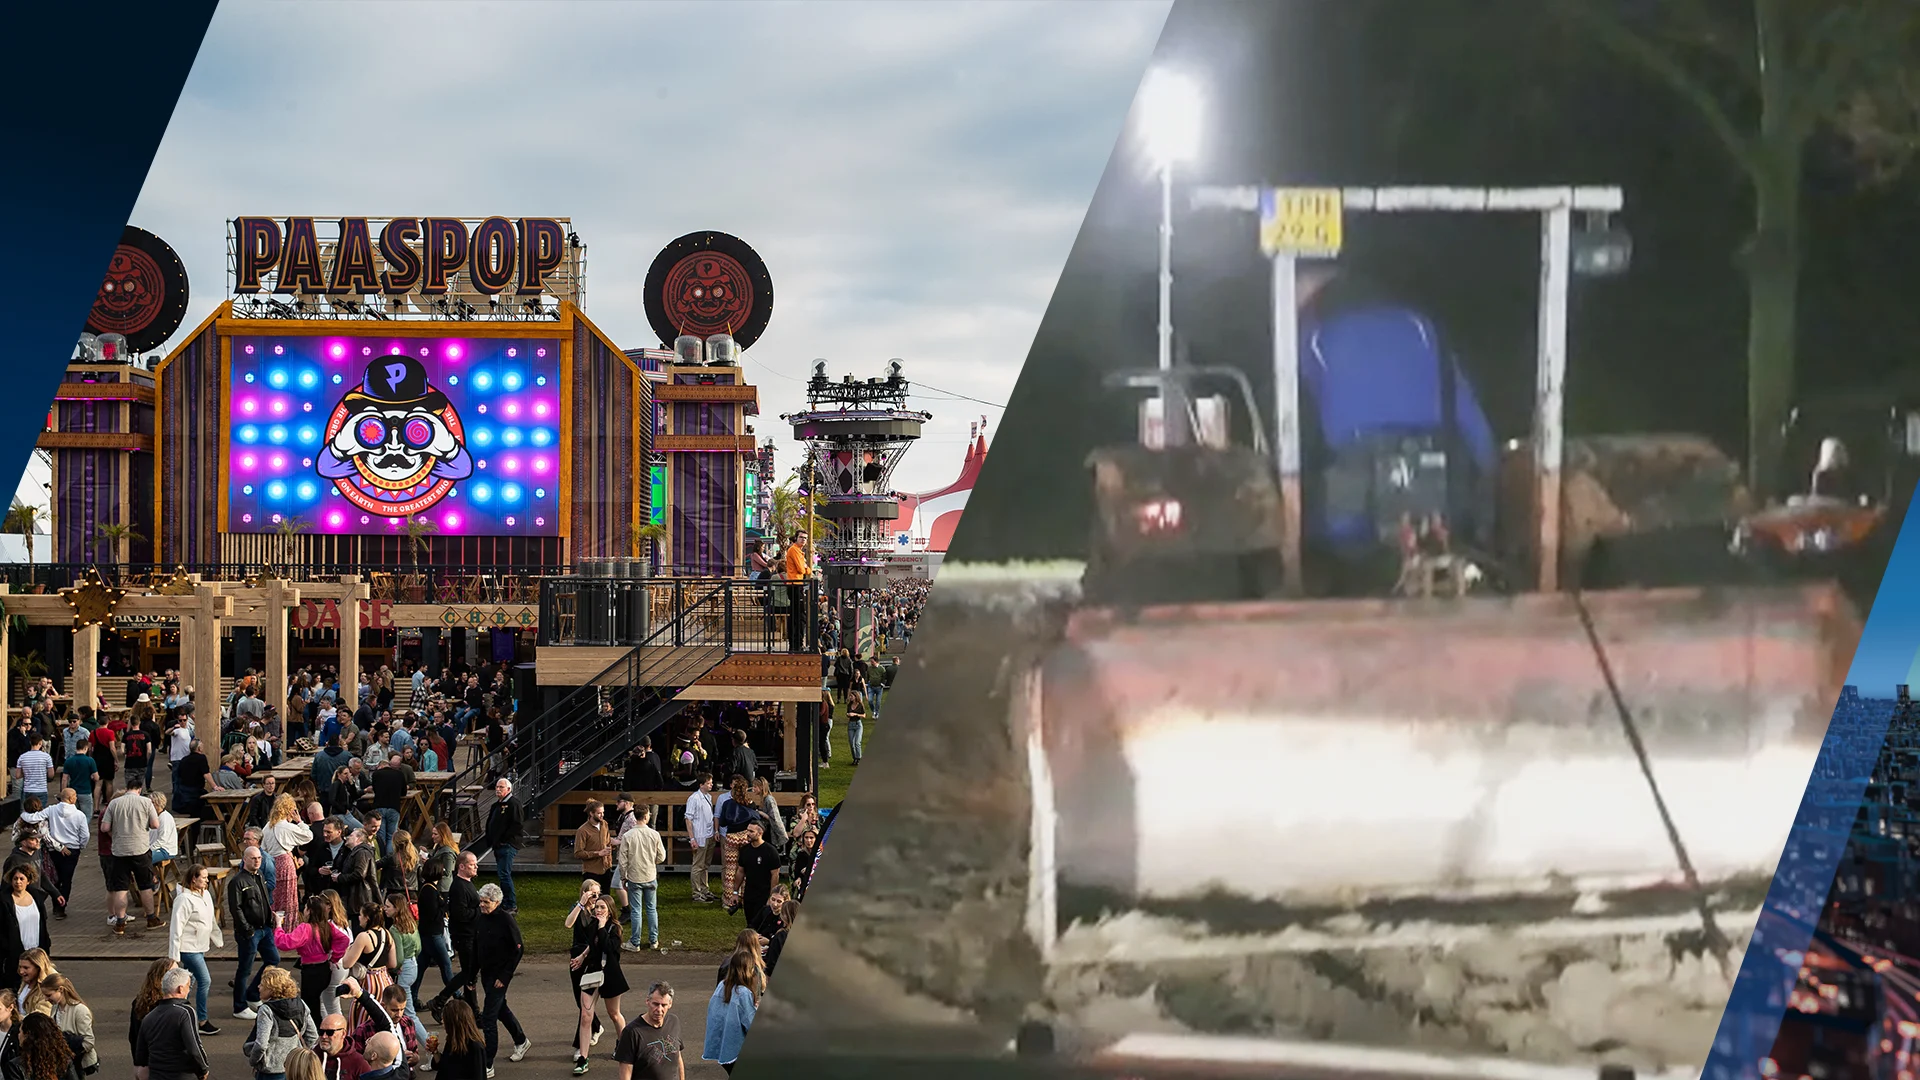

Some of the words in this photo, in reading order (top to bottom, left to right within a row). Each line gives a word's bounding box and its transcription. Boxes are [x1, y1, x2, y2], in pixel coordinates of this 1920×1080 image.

[234, 216, 565, 295] PAASPOP
[336, 407, 348, 419] HE
[341, 482, 351, 493] ON
[350, 491, 374, 509] EARTH
[382, 505, 398, 513] THE
[399, 493, 437, 512] GREATEST
[435, 480, 449, 495] SHO
